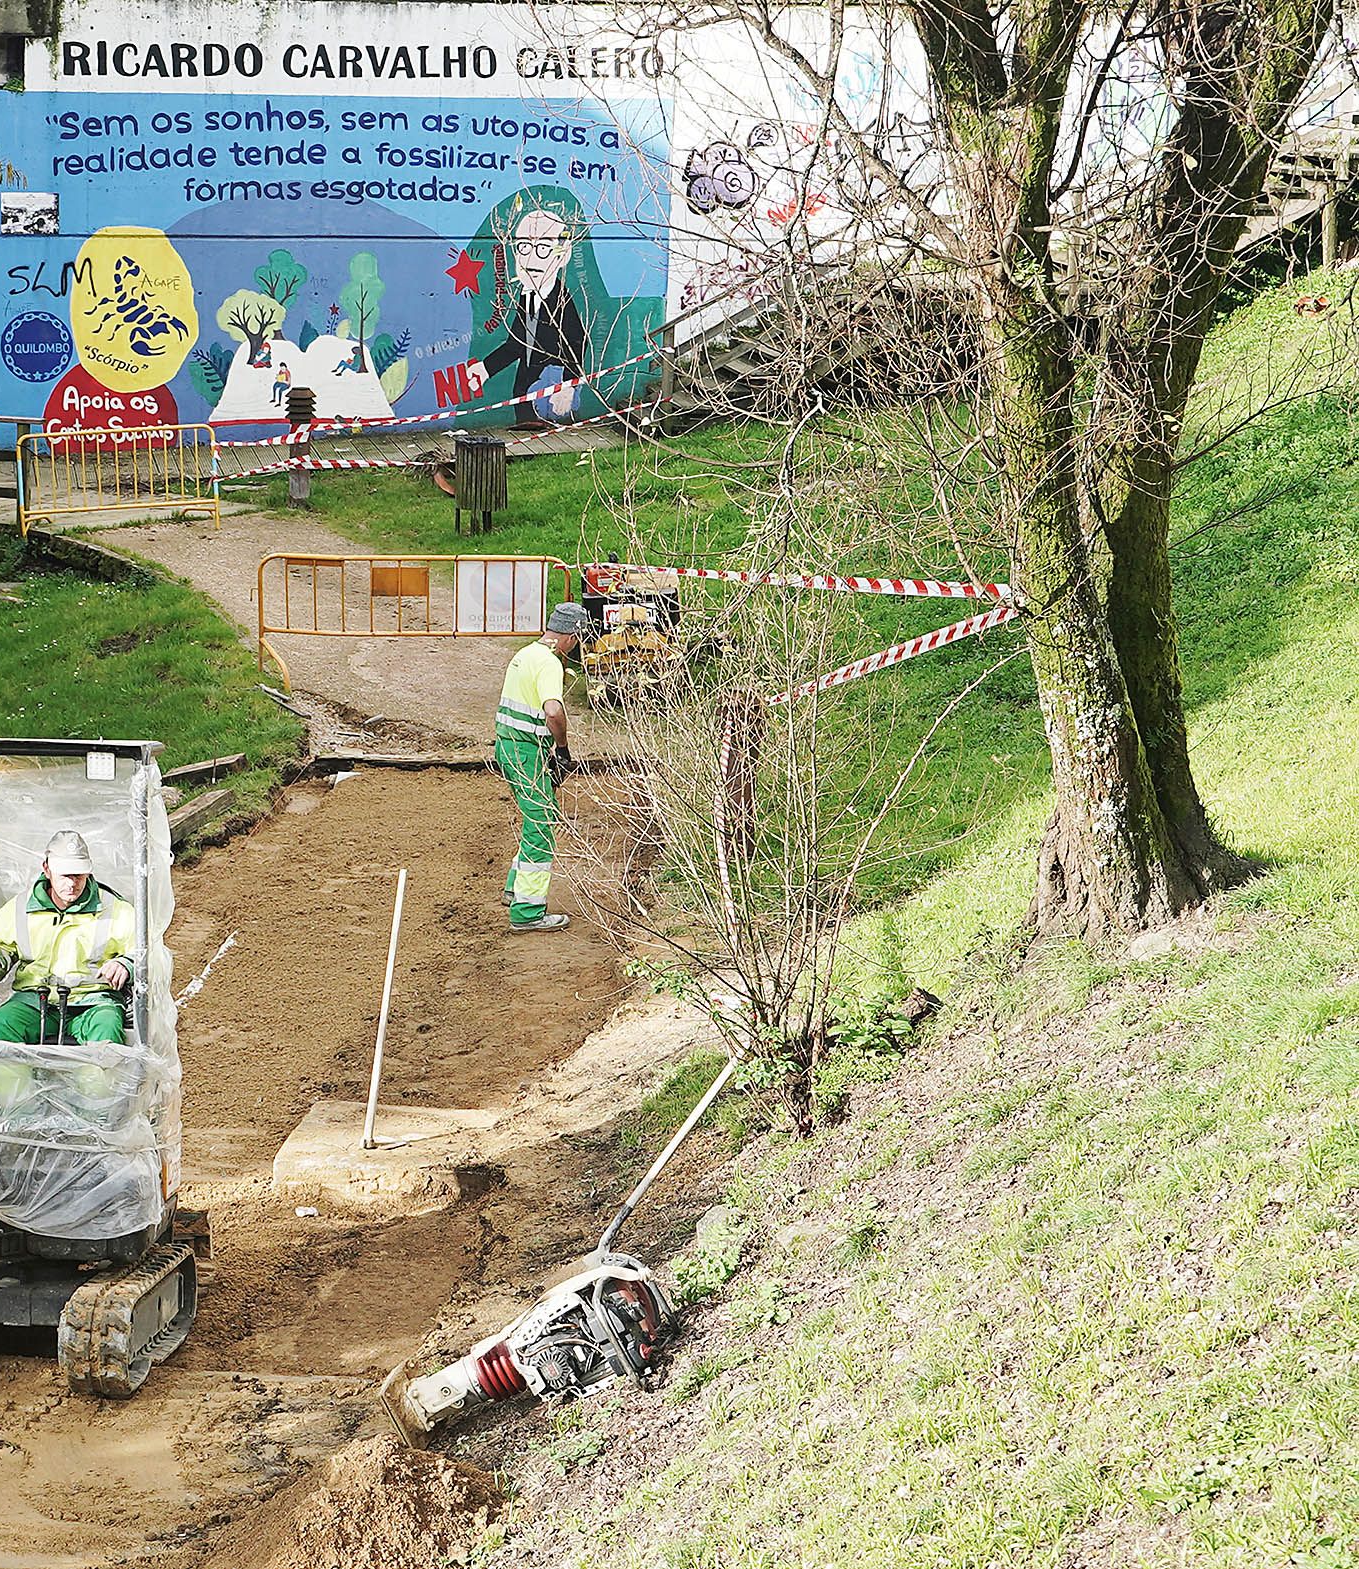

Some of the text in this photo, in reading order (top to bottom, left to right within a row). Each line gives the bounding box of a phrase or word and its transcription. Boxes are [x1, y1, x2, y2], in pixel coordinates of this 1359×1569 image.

[62, 41, 664, 79] RICARDO CARVALHO CALERO
[151, 112, 193, 134] os
[204, 100, 331, 134] sonhos,
[341, 110, 410, 131] sem
[421, 113, 460, 134] as
[471, 115, 590, 147] utopias,
[599, 130, 619, 149] a
[53, 140, 617, 182] realidade tende a fossilizar-se em
[182, 178, 302, 201] formas
[4, 343, 70, 354] O QUILOMBO
[62, 386, 159, 419] Apoia os
